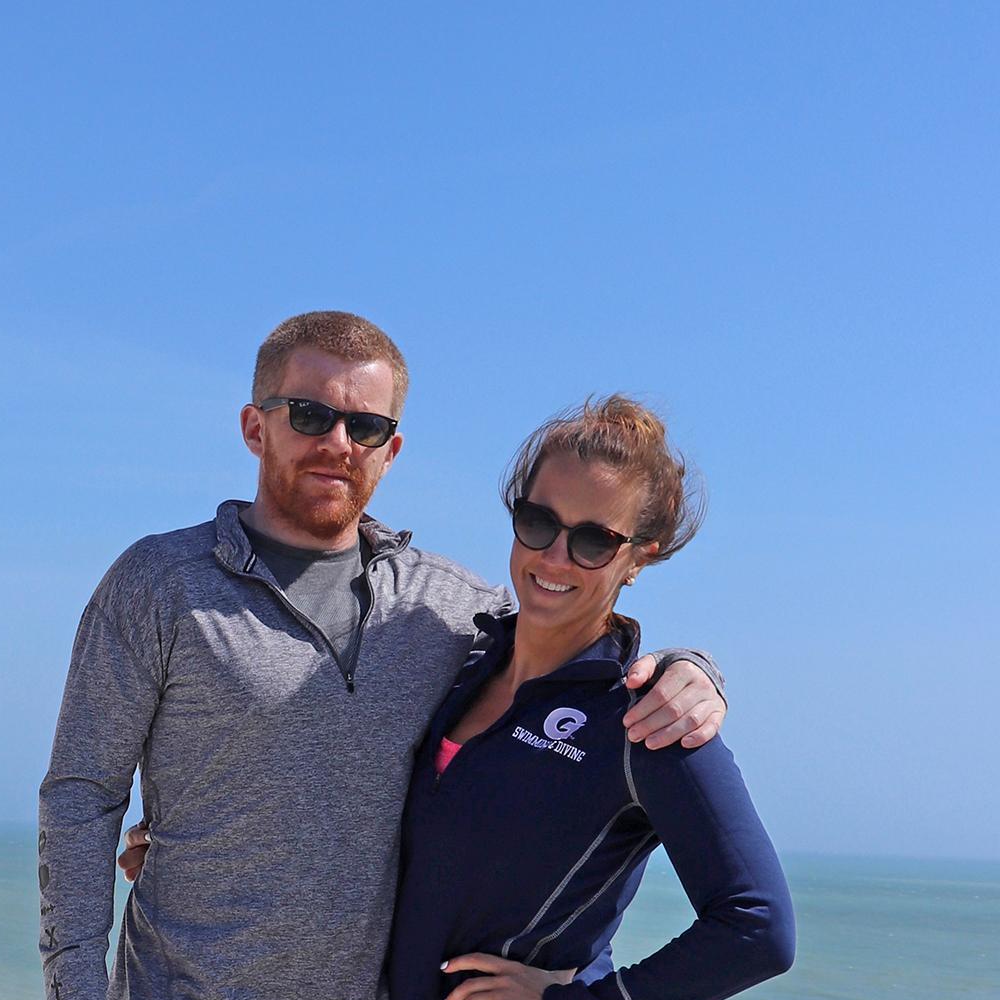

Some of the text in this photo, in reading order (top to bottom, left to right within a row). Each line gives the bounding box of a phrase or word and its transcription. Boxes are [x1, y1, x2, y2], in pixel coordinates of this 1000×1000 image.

[543, 707, 587, 740] G
[512, 726, 550, 749] SWIMM
[554, 741, 586, 762] DIVING
